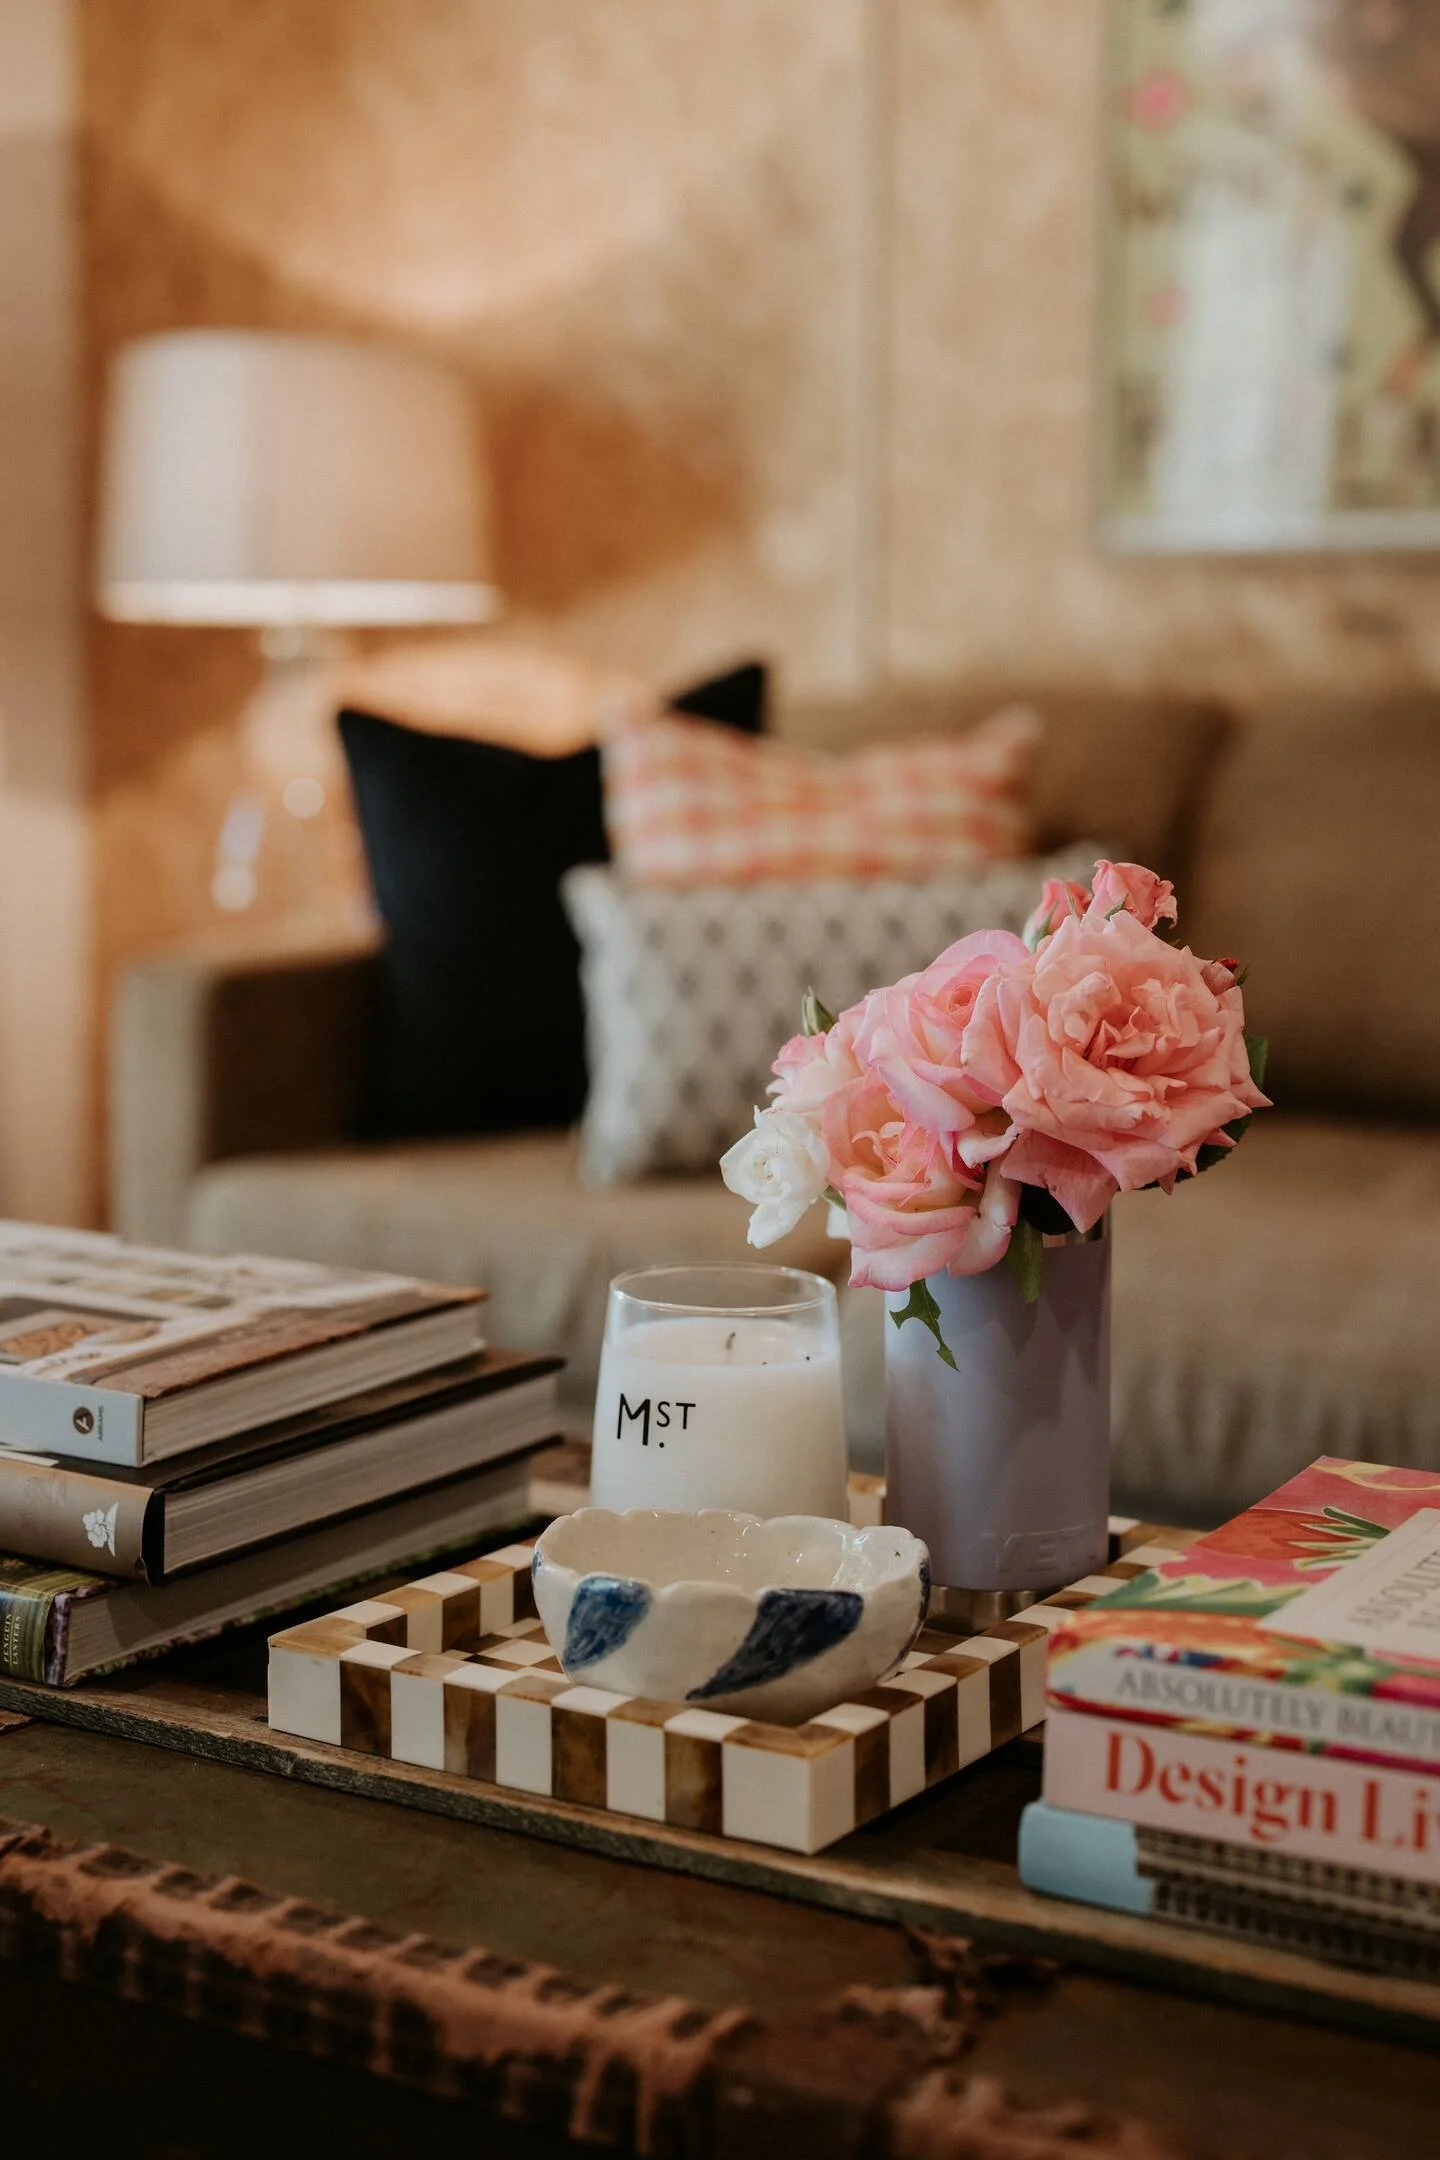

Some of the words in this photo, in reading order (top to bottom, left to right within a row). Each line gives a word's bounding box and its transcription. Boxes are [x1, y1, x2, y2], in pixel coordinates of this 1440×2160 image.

[3, 1613, 12, 1663] PENGUIN
[12, 1616, 21, 1665] LANTERN
[1115, 1668, 1329, 1730] ABSOLUTELY
[1105, 1731, 1337, 1841] Design
[1358, 1779, 1440, 1853] Li
